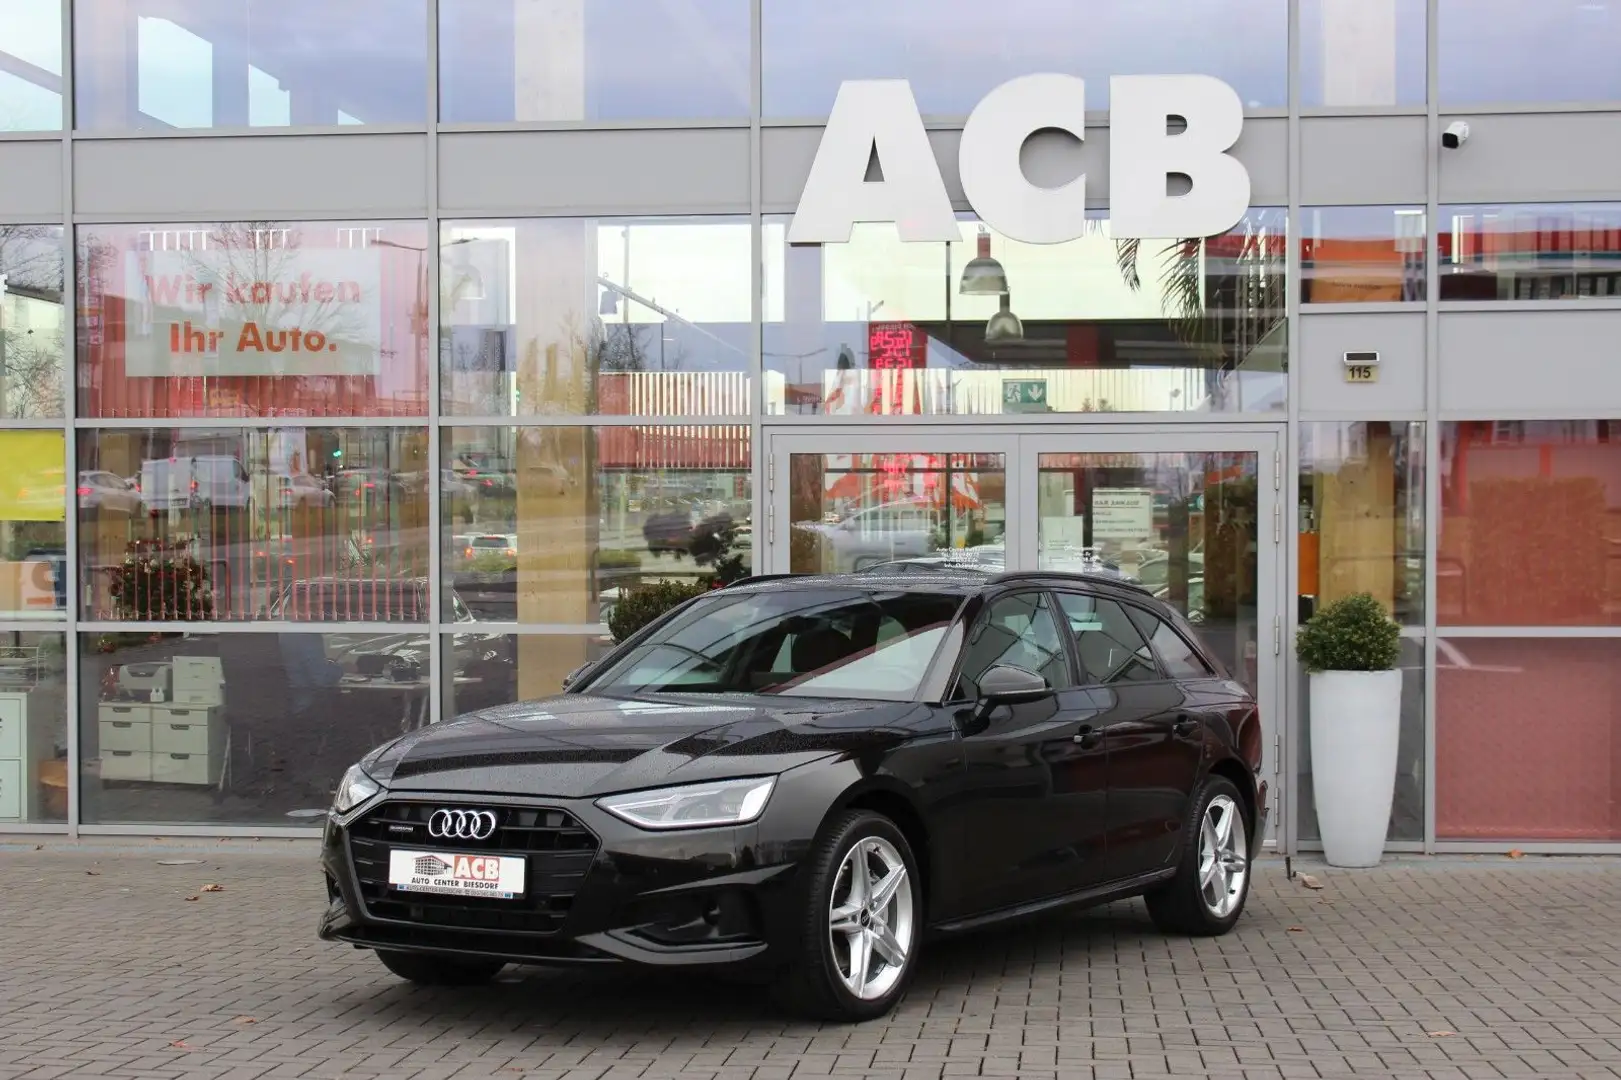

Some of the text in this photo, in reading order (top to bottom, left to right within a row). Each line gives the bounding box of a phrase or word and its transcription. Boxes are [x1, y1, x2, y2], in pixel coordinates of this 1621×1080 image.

[788, 73, 1251, 244] ACB
[145, 271, 361, 304] Wir kaufen
[170, 321, 338, 353] Ihr Auto.
[1349, 366, 1371, 379] 115
[454, 856, 499, 881] ACB
[411, 877, 499, 890] AUTO CENTER BIESDORF
